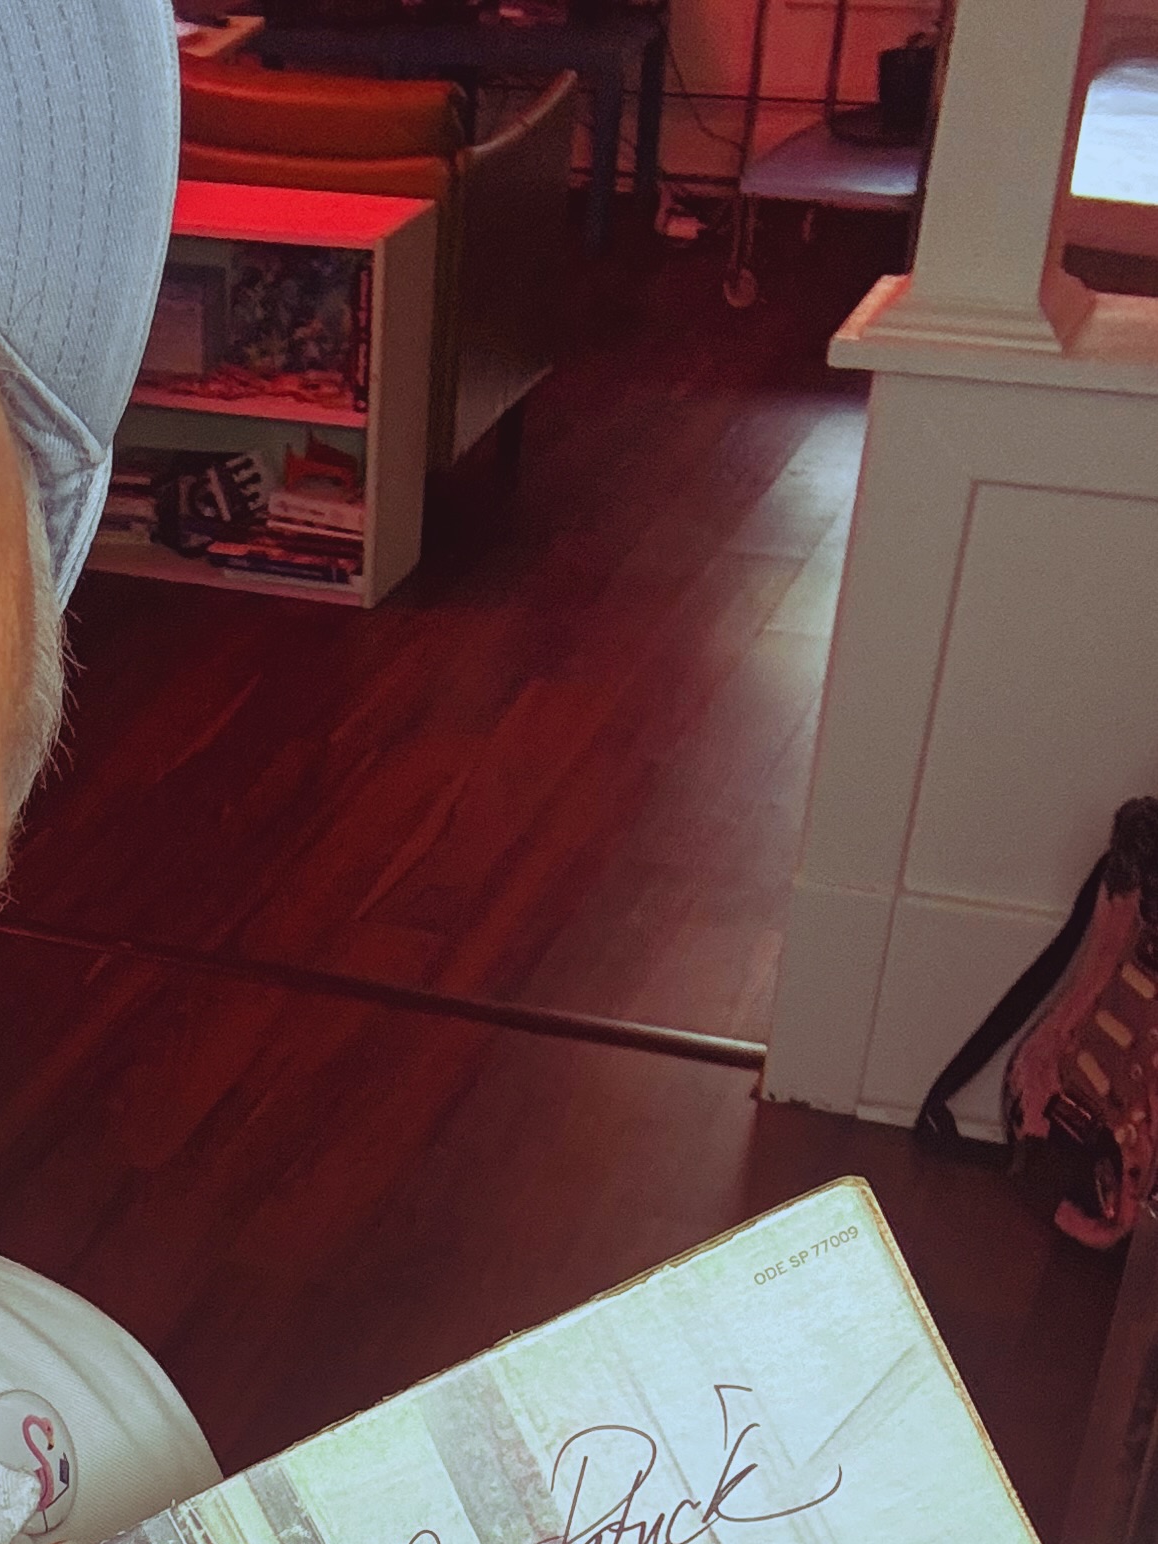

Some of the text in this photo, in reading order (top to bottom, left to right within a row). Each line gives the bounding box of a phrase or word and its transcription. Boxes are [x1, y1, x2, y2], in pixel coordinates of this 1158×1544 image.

[753, 1225, 859, 1285] ODE SP 77009
